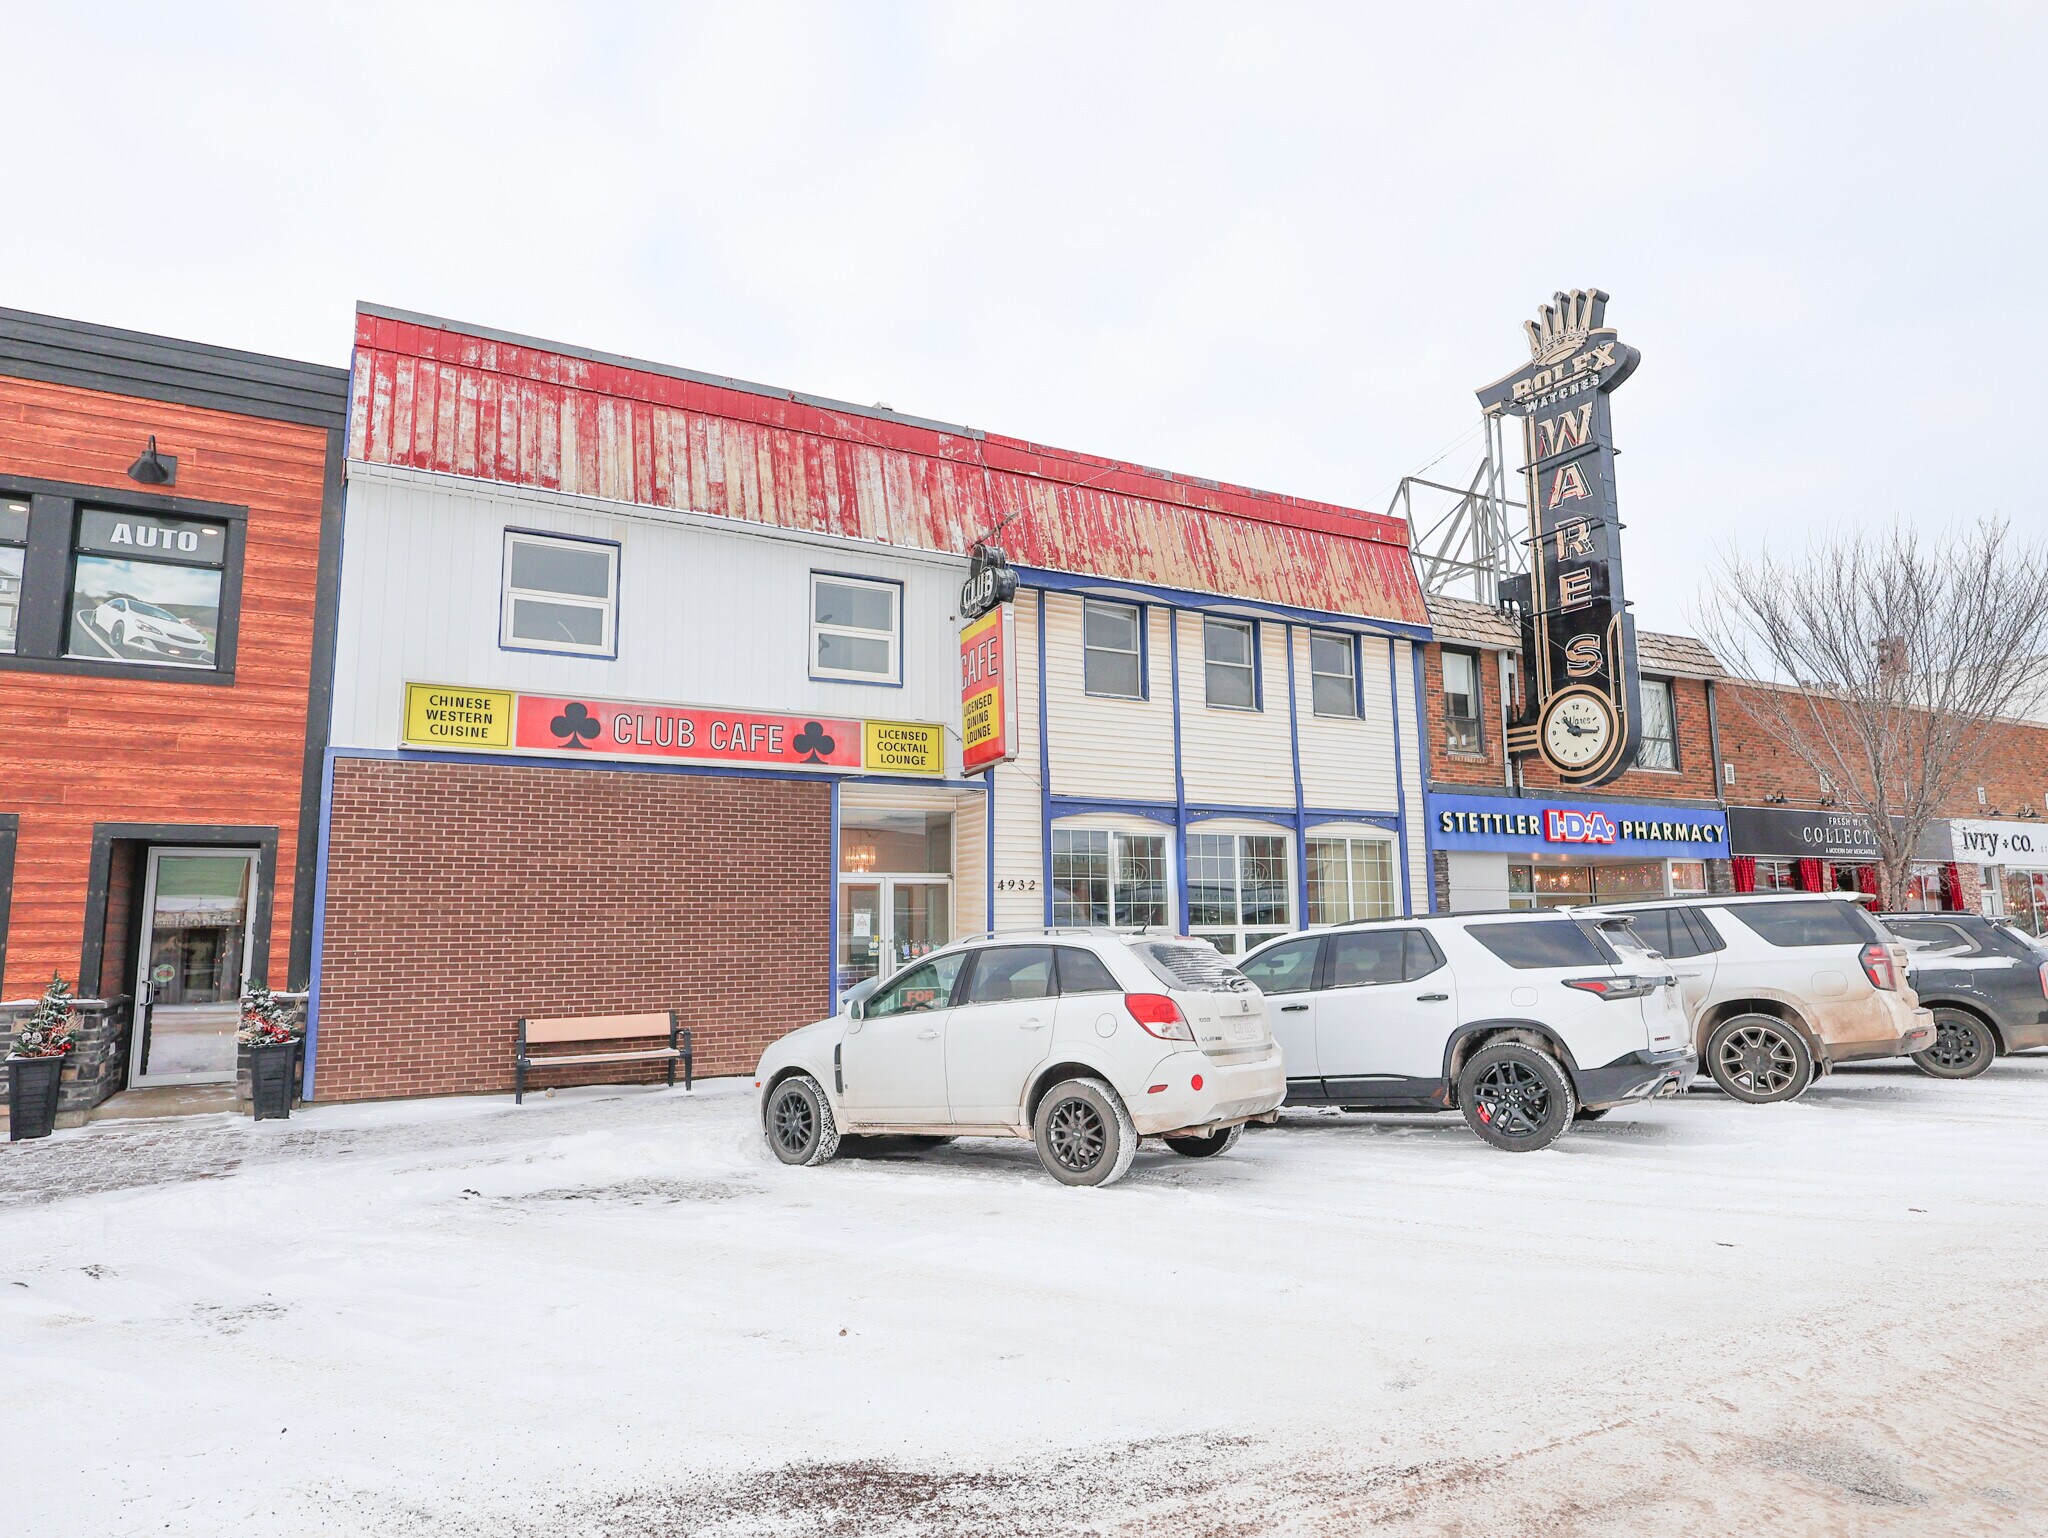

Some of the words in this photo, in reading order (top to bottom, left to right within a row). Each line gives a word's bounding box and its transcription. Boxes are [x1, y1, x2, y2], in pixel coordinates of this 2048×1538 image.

[1511, 341, 1617, 404] ROLEX
[1523, 374, 1600, 413] WATCHES
[110, 522, 199, 553] AUTO
[1538, 401, 1603, 678] WARES
[961, 636, 998, 692] CAFE
[429, 694, 492, 710] CHINESE
[963, 693, 993, 717] LICENSED
[426, 709, 493, 725] WESTERN
[966, 710, 989, 730] DINING
[429, 723, 489, 739] CUISINE
[613, 713, 695, 749] CLUB
[710, 720, 784, 754] CAFE
[878, 729, 928, 742] LICENSED
[966, 723, 992, 745] LOUNGE
[877, 741, 929, 755] COCKTAIL
[880, 754, 926, 766] LOUNGE
[1441, 811, 1541, 835] STETTLER
[1620, 819, 1725, 843] PHARMACY
[1803, 826, 1880, 846] COLLECTI
[1962, 826, 1999, 857] ivry
[997, 879, 1036, 891] 4932
[907, 990, 935, 1002] FOR
